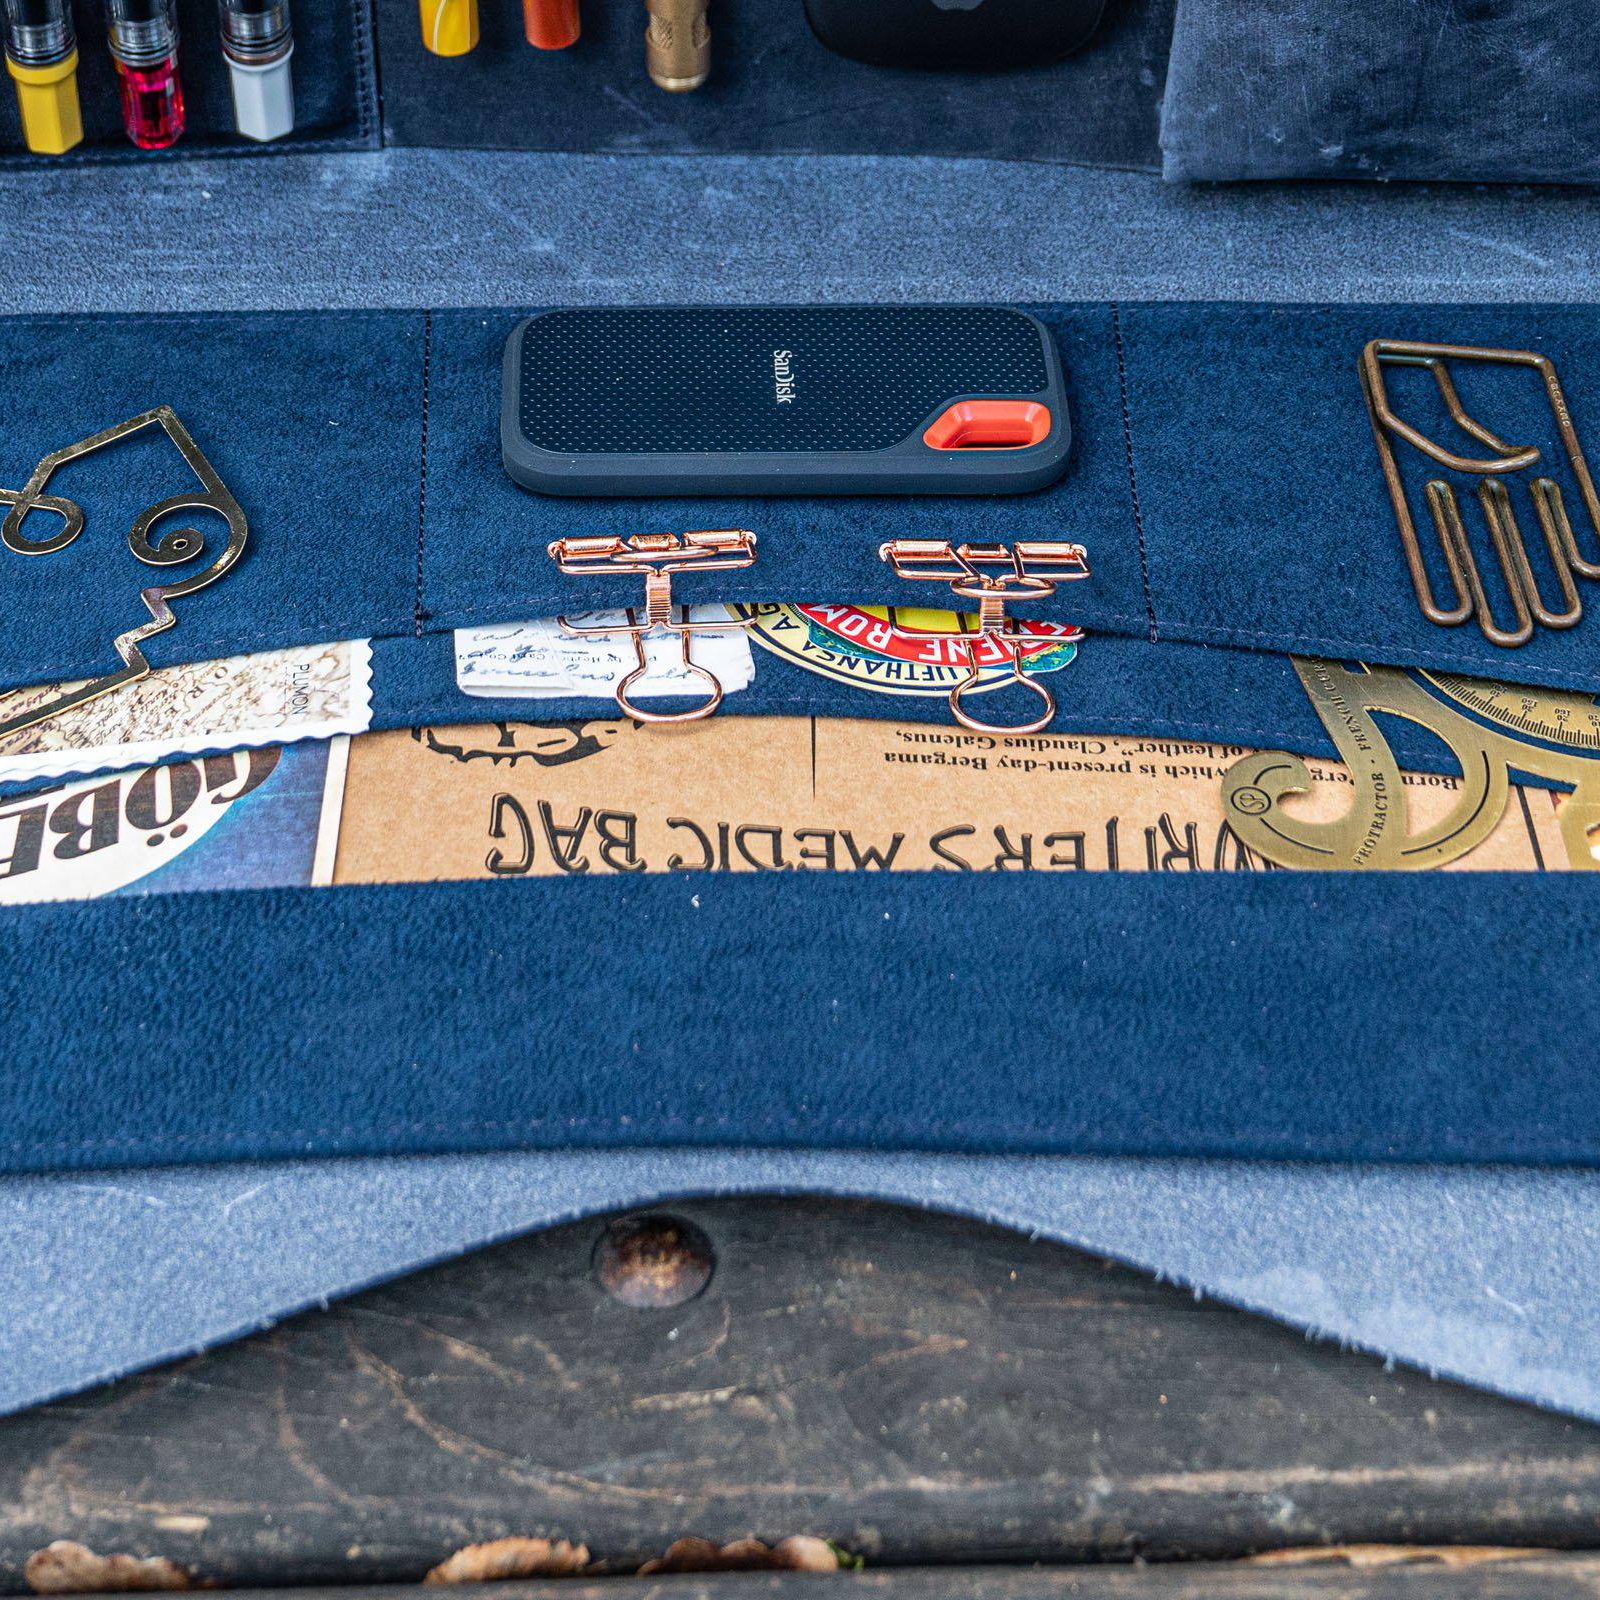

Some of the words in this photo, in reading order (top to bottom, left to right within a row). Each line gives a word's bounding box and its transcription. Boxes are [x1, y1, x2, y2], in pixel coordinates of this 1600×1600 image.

[773, 349, 797, 405] SanDisk
[292, 663, 310, 715] PLUMON
[1331, 695, 1371, 752] FRENCH
[895, 729, 997, 750] Galenus,
[1003, 734, 1107, 755] Claudius
[884, 750, 988, 771] Bergama
[1219, 744, 1243, 759] of
[997, 754, 1132, 776] present-day
[1139, 764, 1158, 778] is
[1401, 774, 1459, 790] Born
[1352, 772, 1389, 866] PROTRACTOR
[484, 792, 648, 875] BAG
[666, 816, 905, 872] MEDIC
